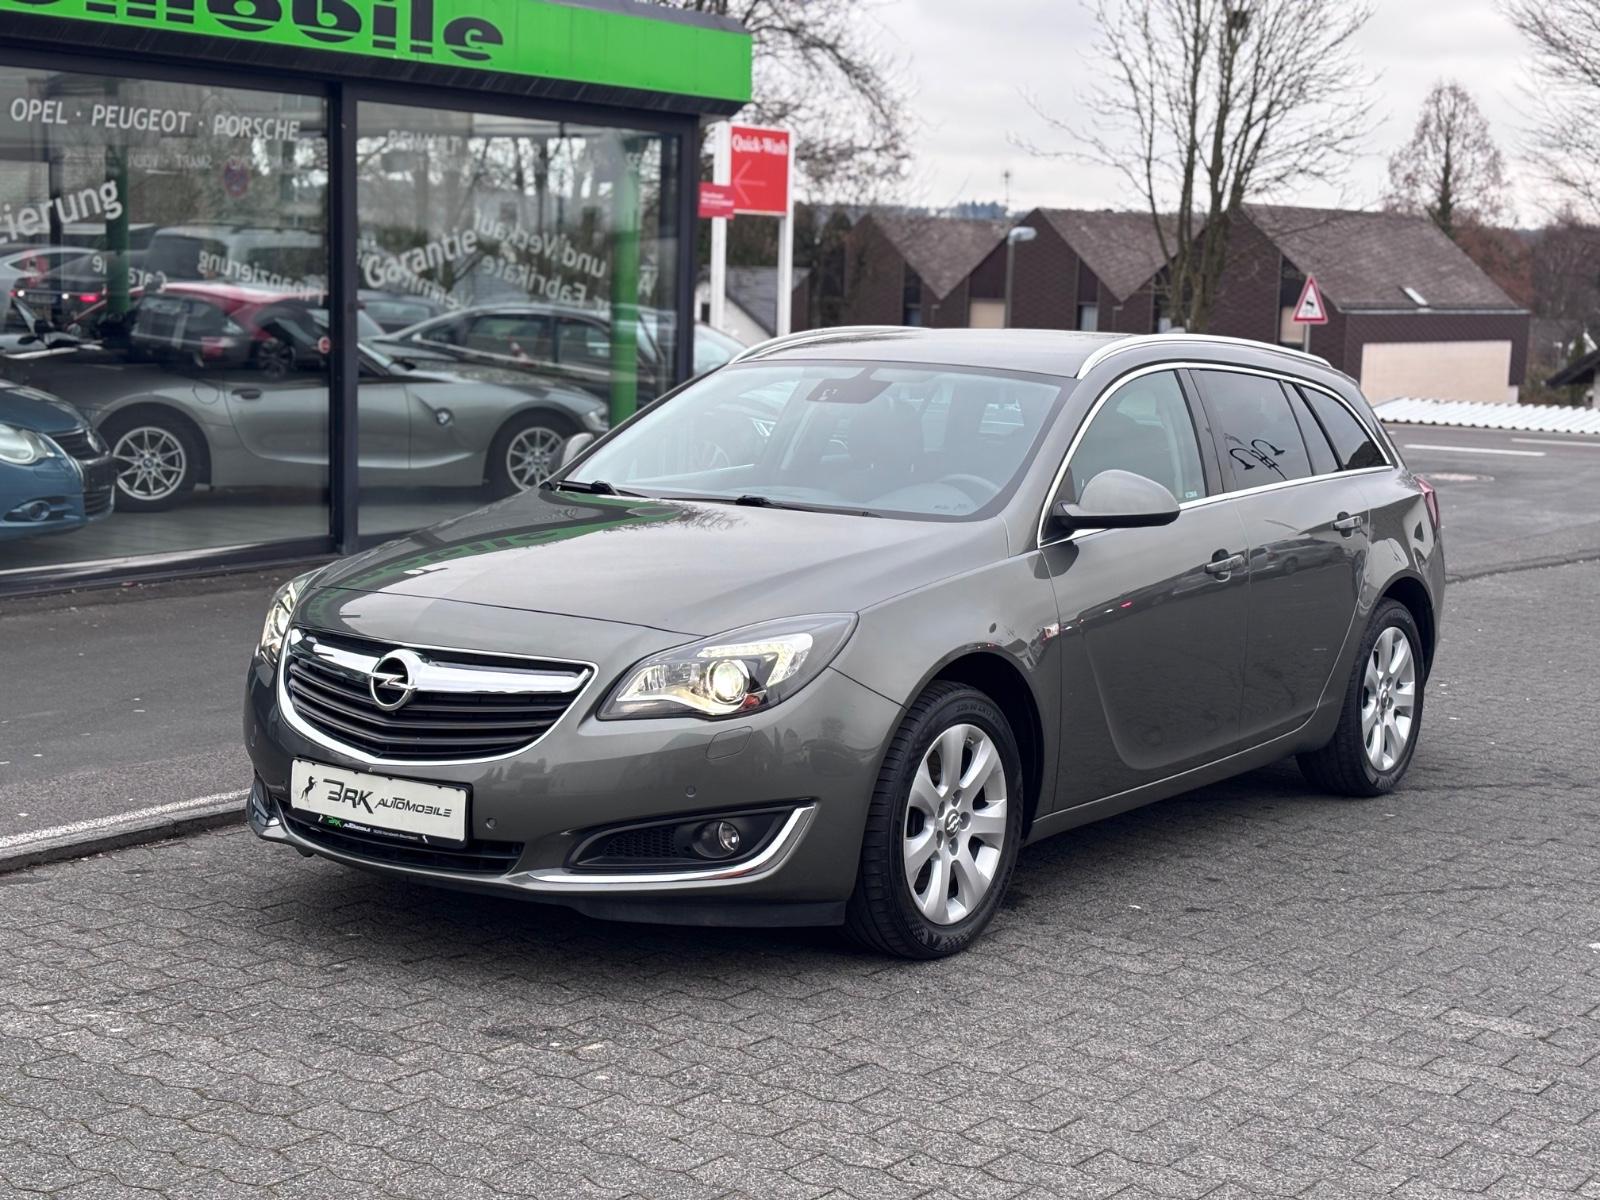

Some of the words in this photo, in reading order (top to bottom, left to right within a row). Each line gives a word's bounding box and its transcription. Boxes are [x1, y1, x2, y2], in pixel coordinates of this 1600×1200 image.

[10, 98, 68, 125] OPEL
[91, 104, 191, 134] PEUGEOT
[213, 114, 300, 141] PORSCHE
[0, 180, 123, 243] ierung
[364, 228, 478, 288] Garantie
